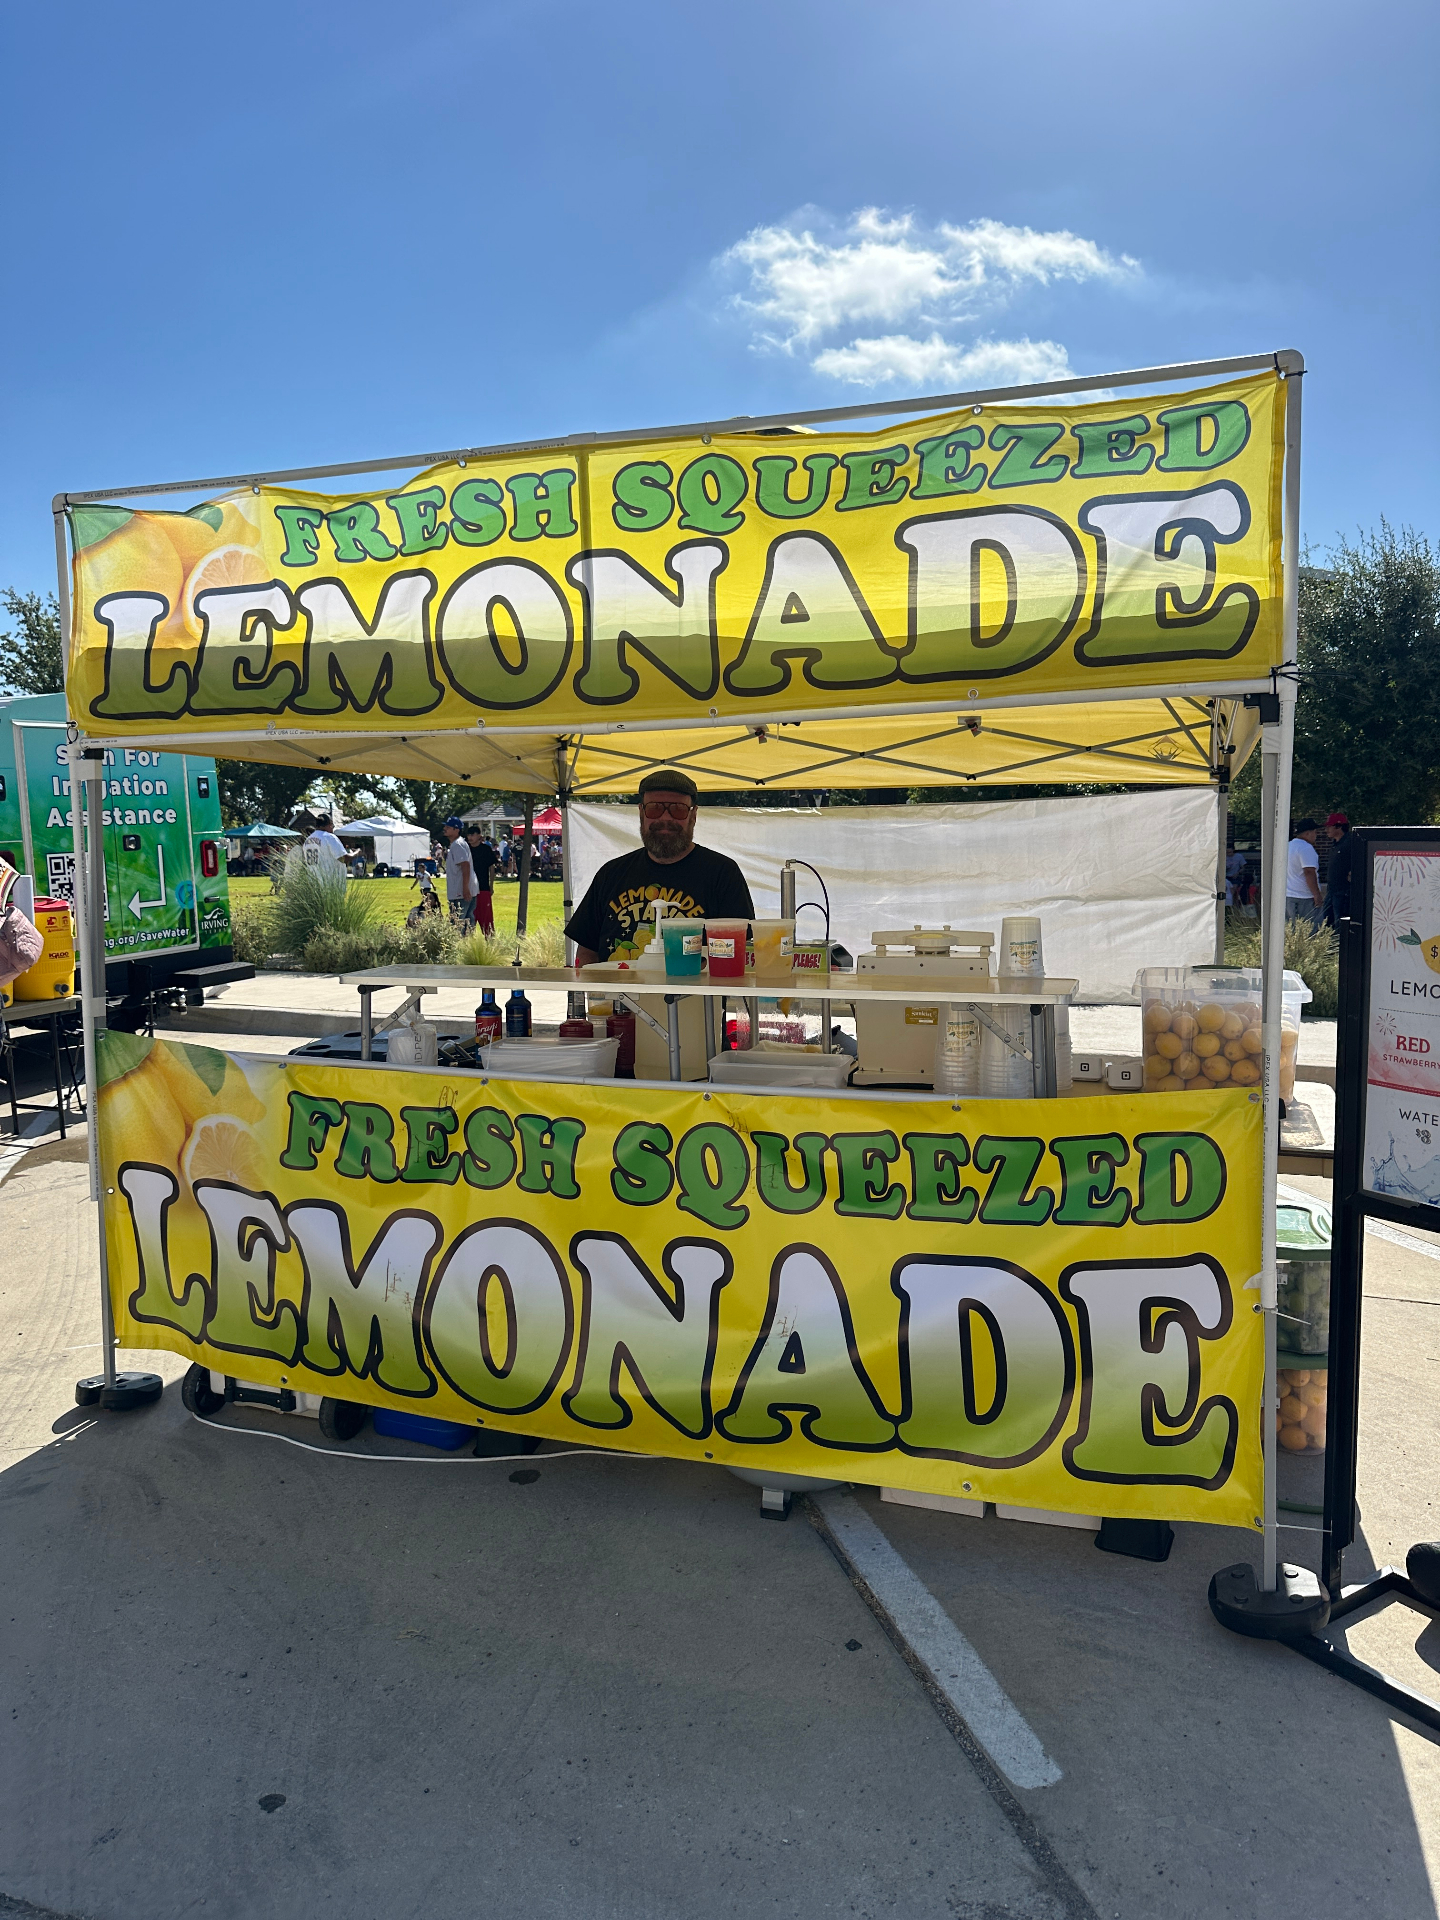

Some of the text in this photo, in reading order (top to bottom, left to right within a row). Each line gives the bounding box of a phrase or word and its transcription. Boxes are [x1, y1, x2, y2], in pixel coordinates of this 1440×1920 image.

[273, 400, 1251, 567] FRESH SQUEEZED
[90, 480, 1260, 718] LEMONADE
[56, 743, 160, 767] Sn For
[52, 773, 168, 800] Iration
[46, 806, 177, 828] Assstance
[609, 885, 705, 918] LEMONADE
[201, 918, 228, 930] IRVING
[617, 901, 686, 927] STAN
[104, 928, 190, 949] ng.org/SaveWater
[793, 953, 821, 969] PLEASE!
[1390, 979, 1440, 999] LEMO
[1396, 1034, 1431, 1054] RED
[1382, 1053, 1440, 1070] STRAWBERRY
[1399, 1108, 1440, 1127] WATE
[280, 1090, 586, 1199] FRESH
[610, 1121, 1227, 1230] SQUEEZED
[118, 1161, 1238, 1490] LEMONADE
